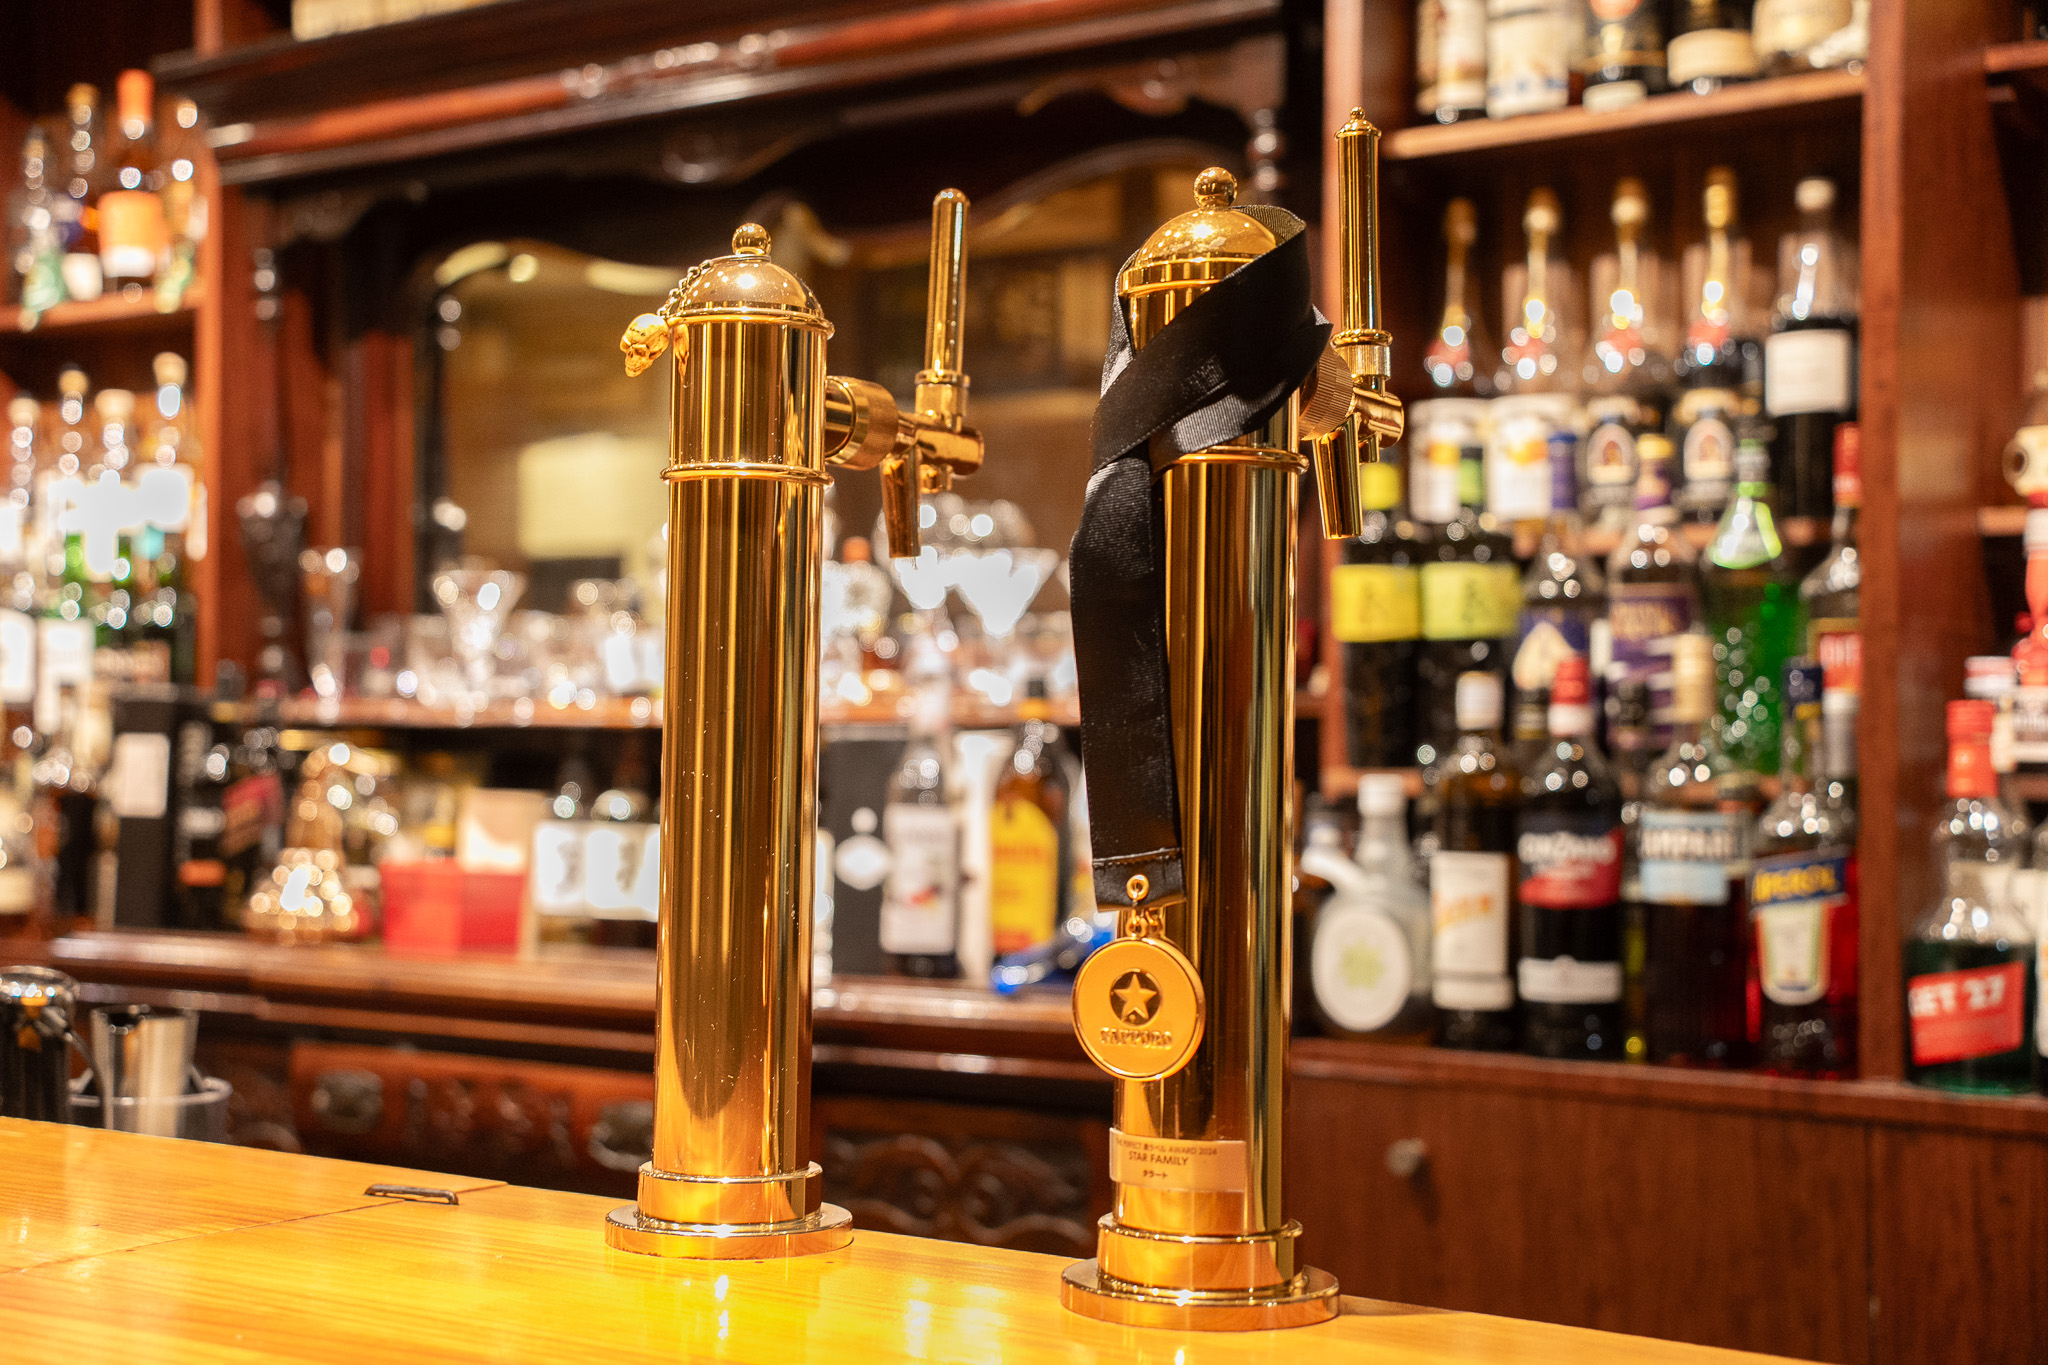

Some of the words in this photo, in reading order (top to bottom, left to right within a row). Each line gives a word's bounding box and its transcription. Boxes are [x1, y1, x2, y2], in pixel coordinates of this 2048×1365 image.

[1100, 1027, 1172, 1050] SAPPORO
[1129, 1151, 1148, 1162] STAR
[1150, 1154, 1189, 1166] FAMILY
